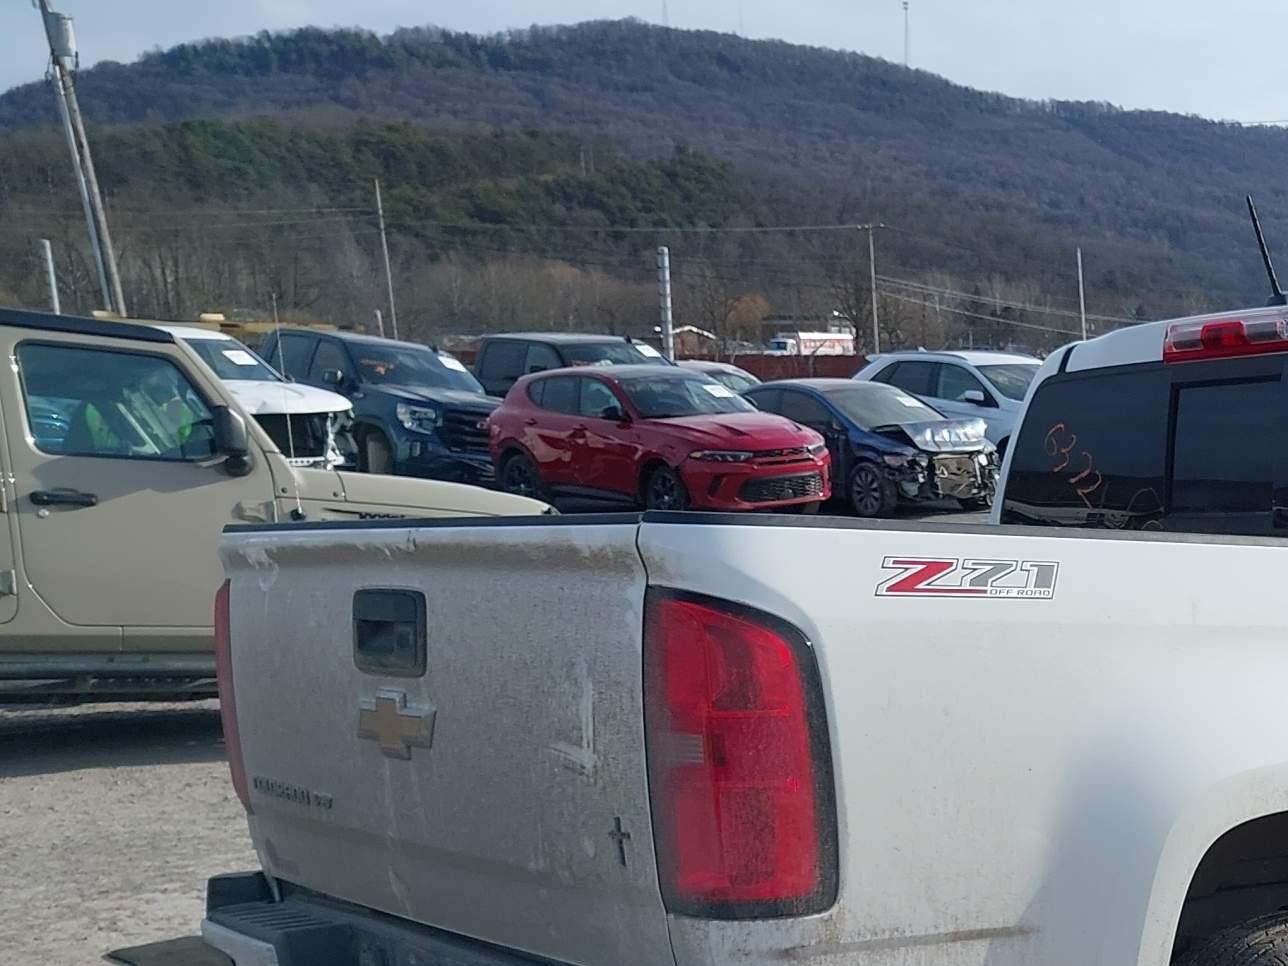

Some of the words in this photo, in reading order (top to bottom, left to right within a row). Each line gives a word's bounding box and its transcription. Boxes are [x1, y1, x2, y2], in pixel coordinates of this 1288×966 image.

[875, 556, 1060, 599] Z71
[989, 588, 1015, 597] OFF
[1017, 588, 1050, 598] ROAD
